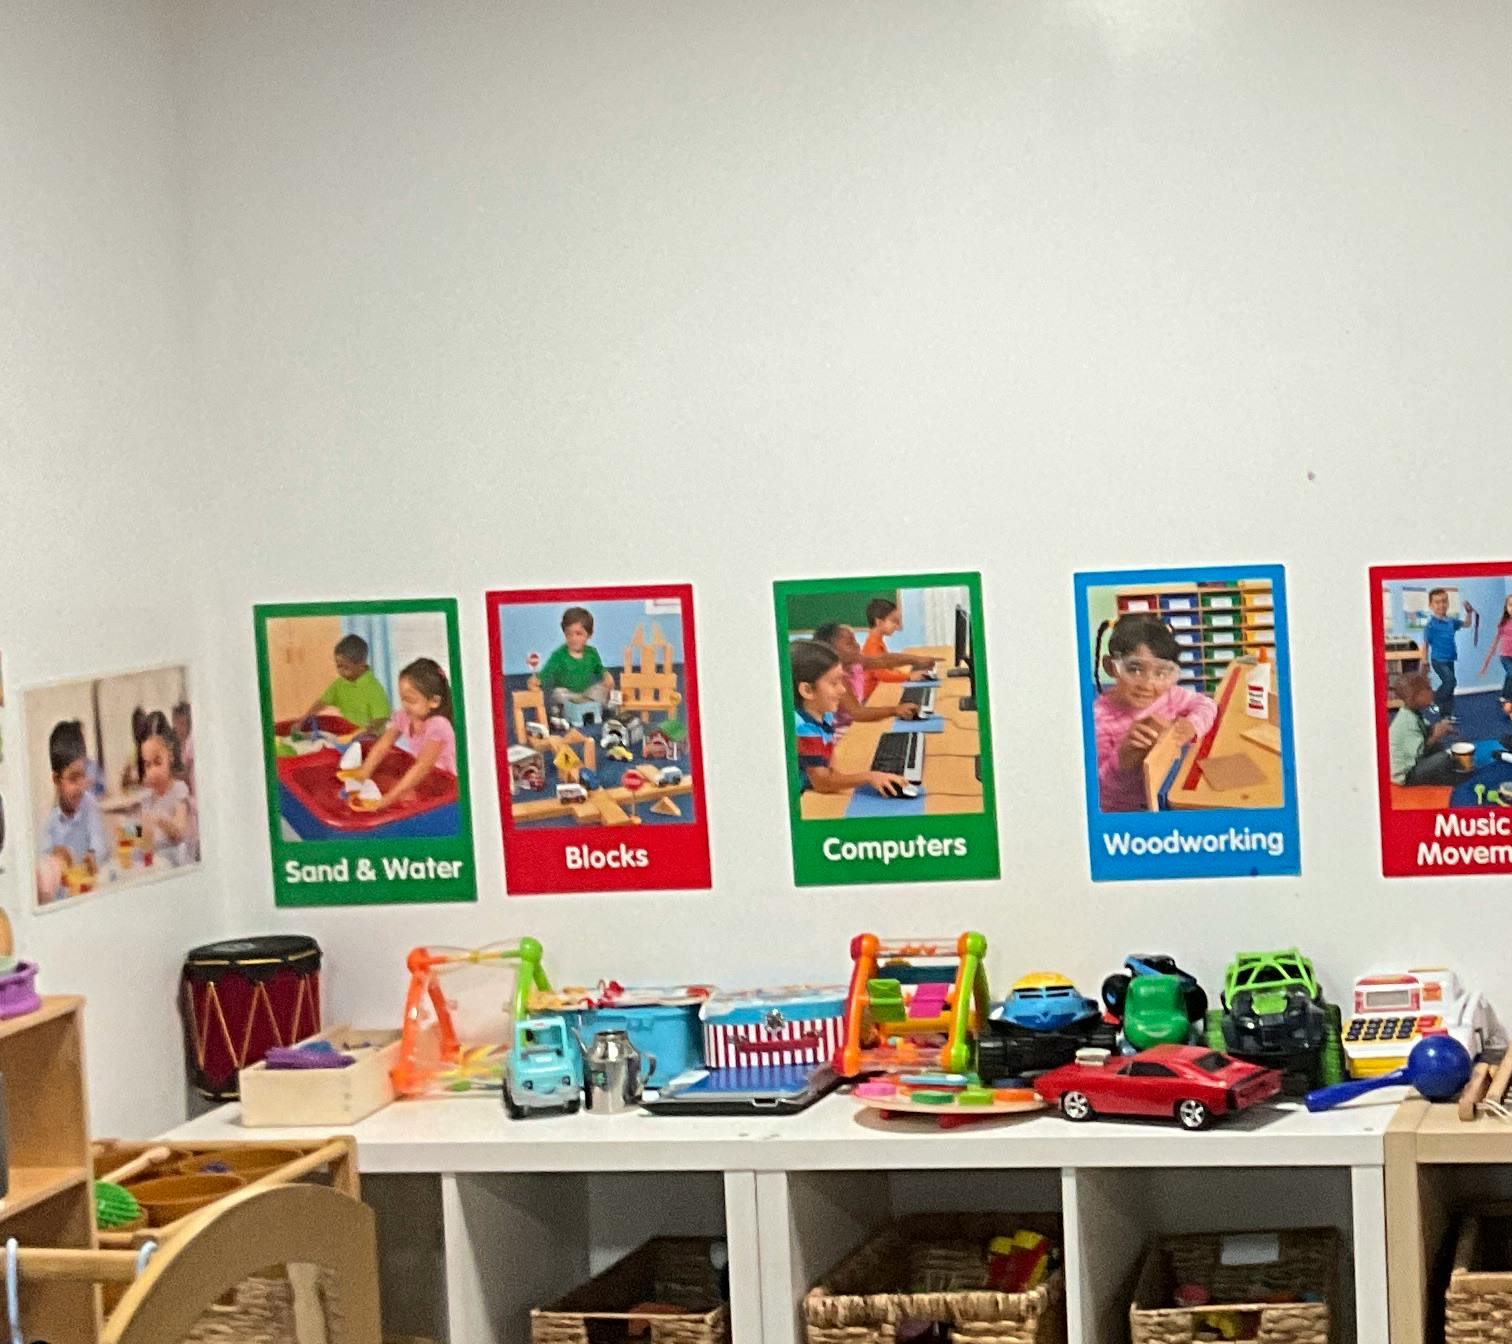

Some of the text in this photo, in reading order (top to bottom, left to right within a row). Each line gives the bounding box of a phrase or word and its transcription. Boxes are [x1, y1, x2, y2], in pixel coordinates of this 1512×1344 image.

[1434, 813, 1511, 838] Music
[822, 835, 968, 865] Computers
[1103, 827, 1284, 857] Woodworking
[564, 843, 650, 870] Blocks
[286, 858, 463, 883] Sand & Water
